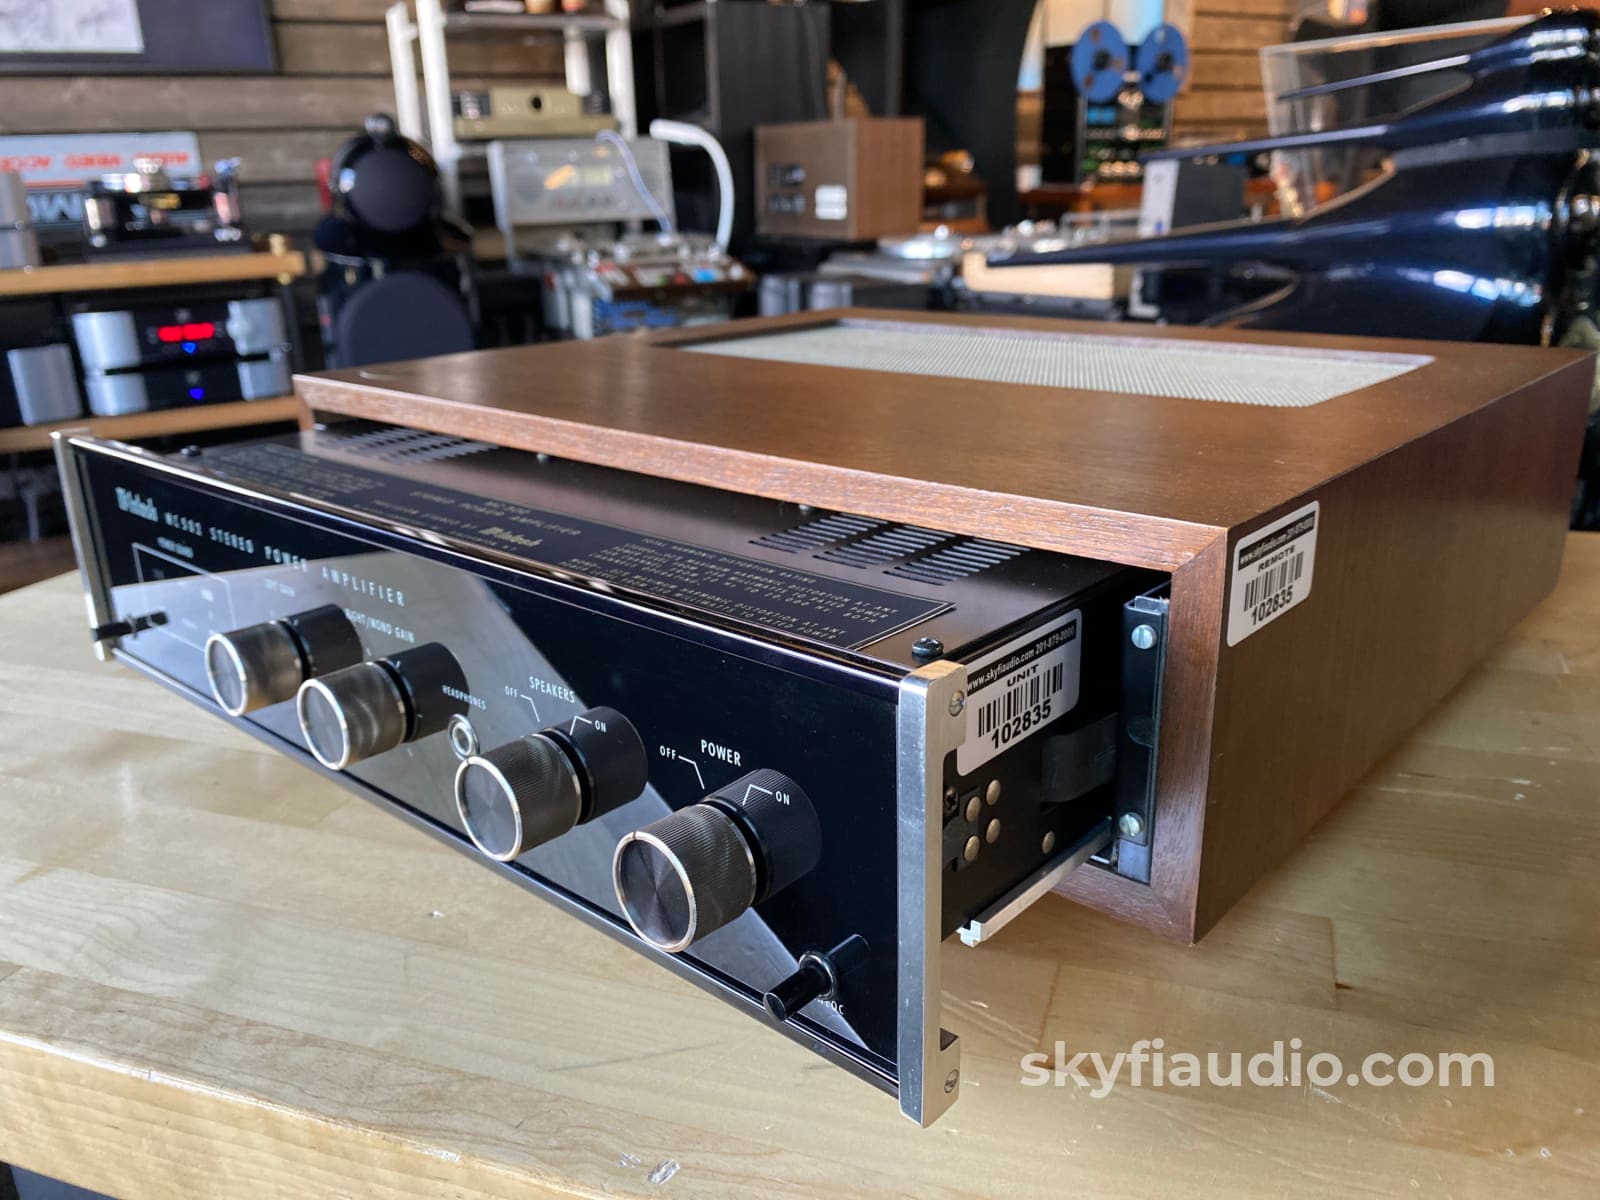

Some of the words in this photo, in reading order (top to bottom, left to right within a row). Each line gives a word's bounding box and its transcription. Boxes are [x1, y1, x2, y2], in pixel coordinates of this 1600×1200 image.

[209, 526, 254, 554] STEREO
[264, 545, 307, 573] POWER
[322, 565, 404, 607] AMPLIFIER
[1258, 545, 1296, 572] REMOTE
[787, 584, 851, 601] DISTORTION
[734, 603, 798, 622] DISTORTION
[809, 597, 845, 607] RATED
[849, 607, 888, 618] POWER
[1251, 585, 1293, 626] 102835
[756, 617, 793, 628] RATED
[795, 628, 834, 639] POWER
[841, 613, 877, 623] BOTH
[1007, 664, 1039, 687] UNIT
[442, 684, 486, 711] HEADPHONES
[504, 685, 518, 698] OFF
[529, 675, 575, 704] SPEAKERS
[595, 720, 606, 733] ON
[991, 699, 1051, 749] 102835
[659, 745, 676, 760] OFF
[701, 739, 741, 767] POWER
[776, 790, 790, 806] ON
